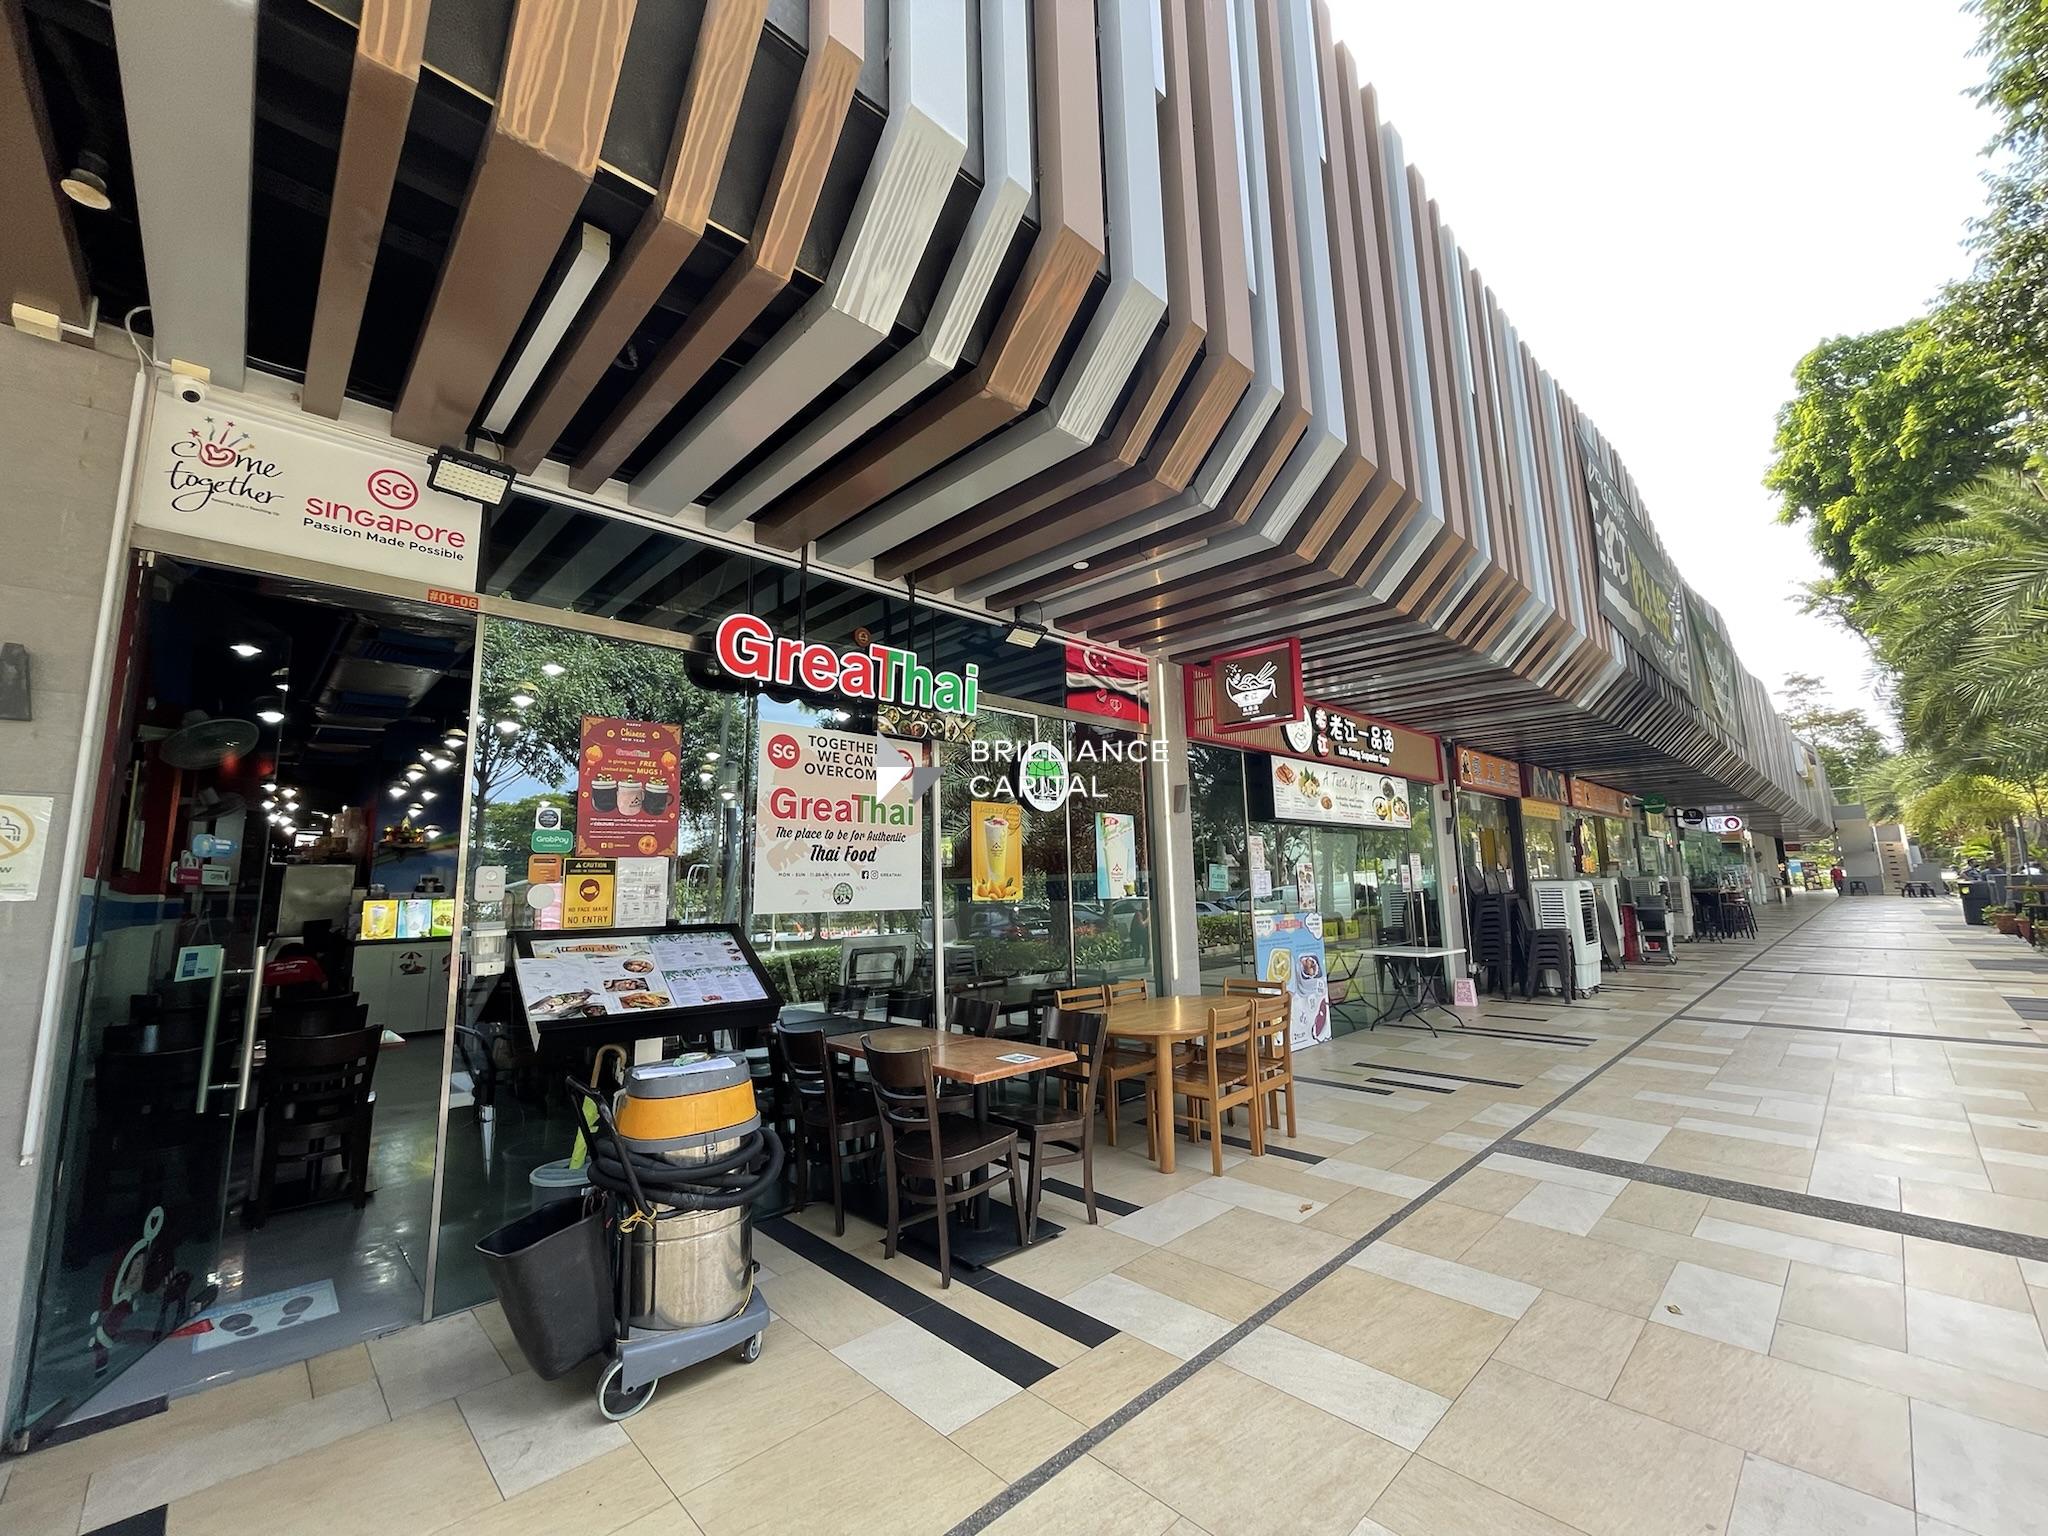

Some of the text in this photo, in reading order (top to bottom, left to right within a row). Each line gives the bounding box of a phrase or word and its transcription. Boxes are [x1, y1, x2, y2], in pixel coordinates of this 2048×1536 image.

[164, 461, 284, 512] together
[375, 478, 413, 501] SG
[303, 517, 465, 562] Passion Made Possible
[428, 590, 478, 610] #01-06
[716, 613, 979, 716] GreaThai
[620, 728, 647, 738] Chinese
[772, 743, 797, 759] SG
[807, 735, 878, 755] TOGETHE
[639, 760, 657, 768] FREE
[818, 751, 874, 767] WE CAN
[636, 768, 658, 776] MUGS
[804, 762, 878, 780] OVERCOM
[770, 787, 915, 826] GreaThai
[536, 835, 569, 845] GrabPay
[775, 826, 906, 843] The place to be for Authentic
[809, 844, 877, 863] Thai Food
[567, 915, 608, 924] NO ENTRY
